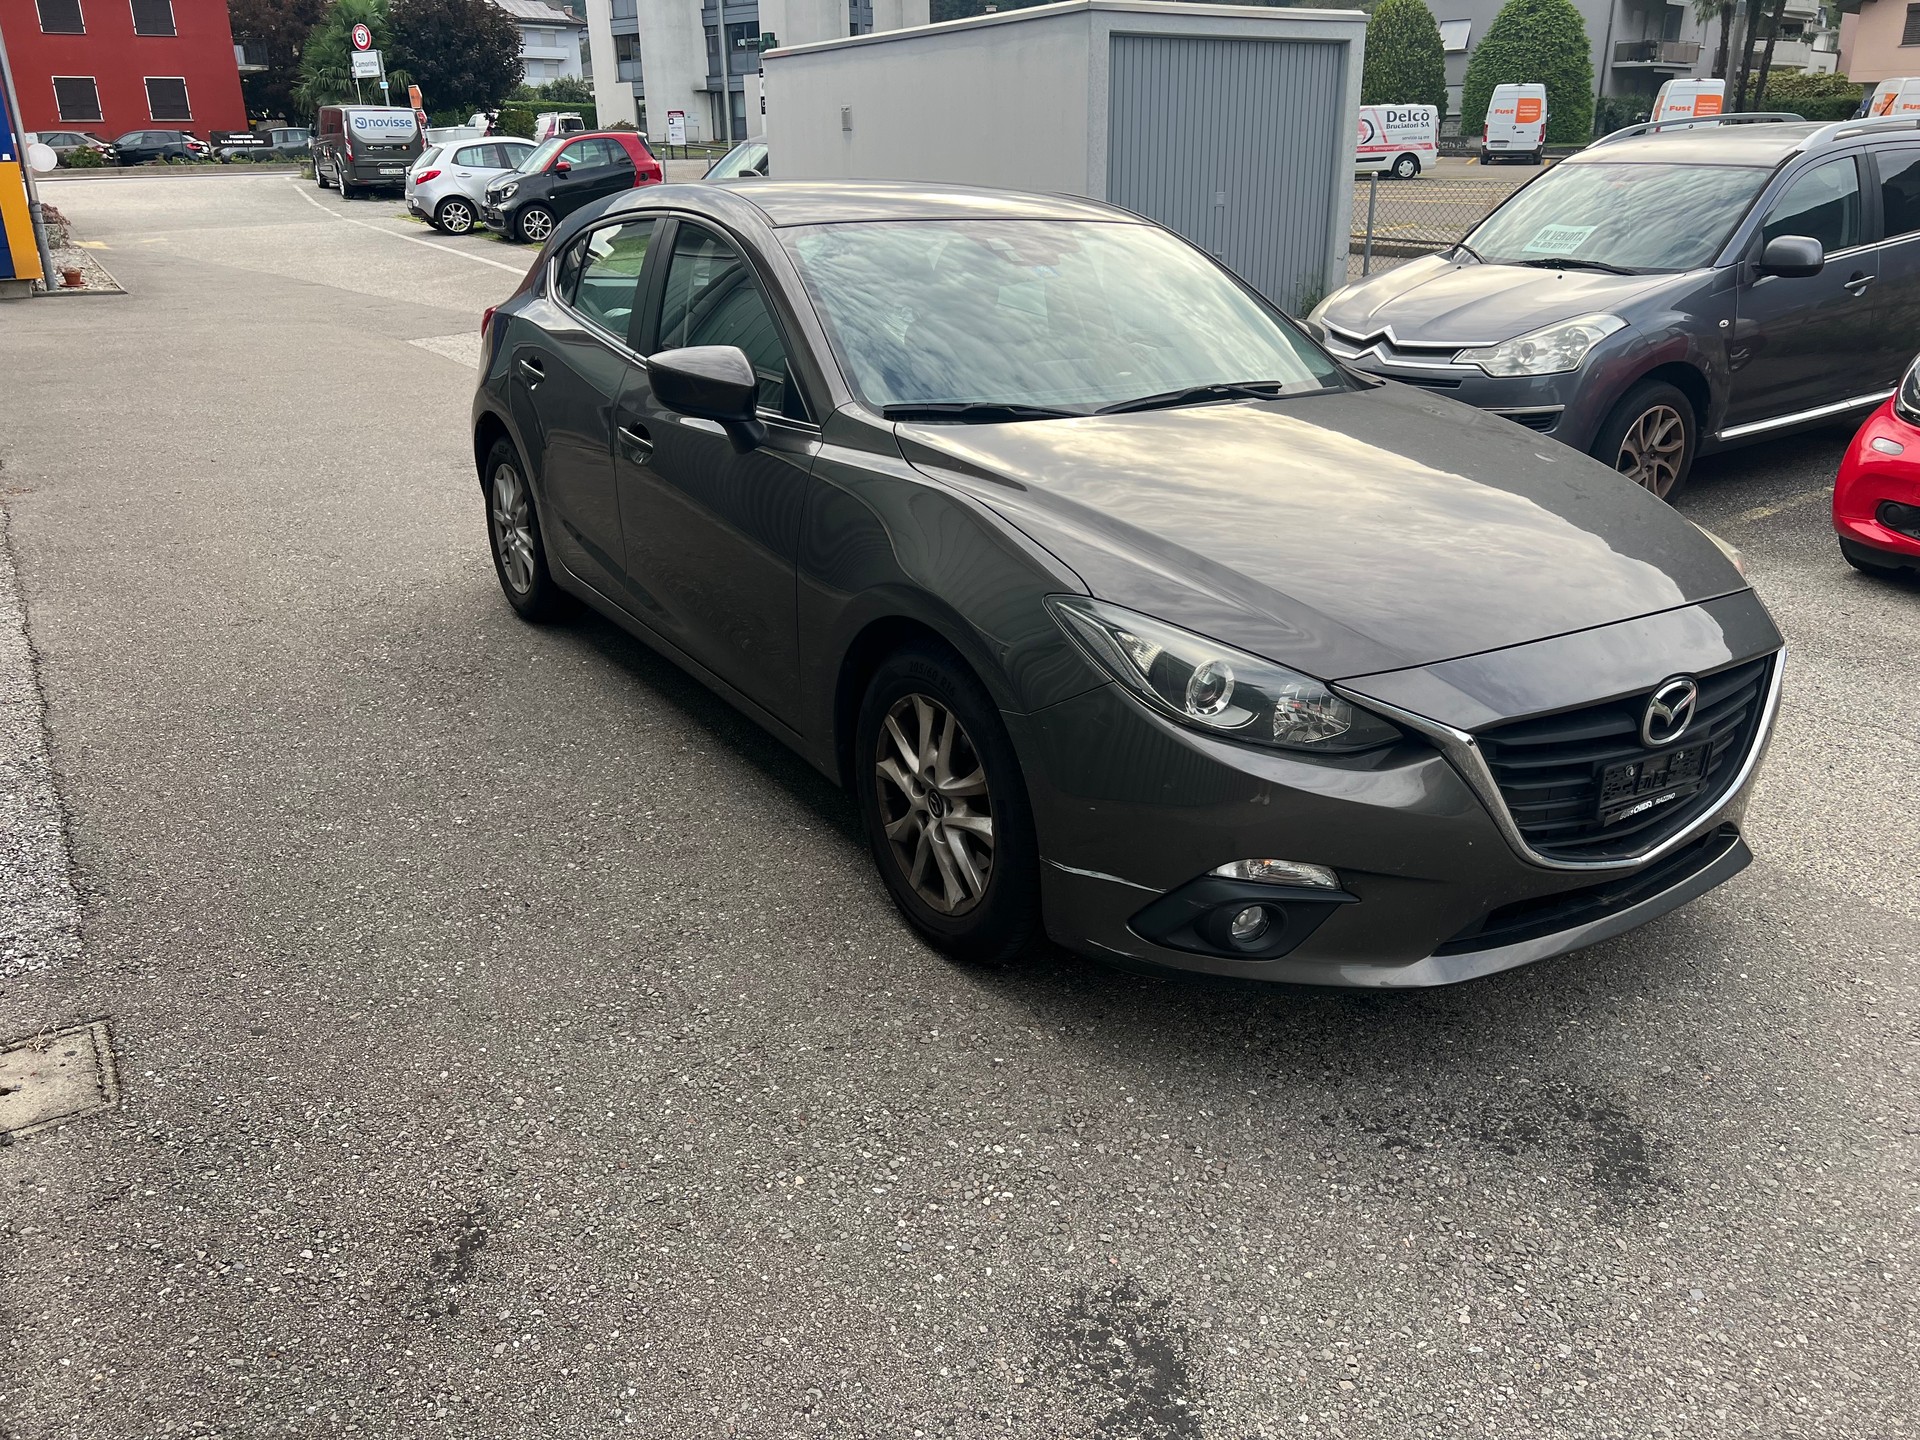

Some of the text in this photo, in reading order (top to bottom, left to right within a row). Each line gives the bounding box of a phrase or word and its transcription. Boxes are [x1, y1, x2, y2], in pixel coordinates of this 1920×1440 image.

[357, 33, 366, 42] 50
[355, 60, 378, 68] Camorino
[1386, 108, 1430, 123] Delcò
[368, 117, 413, 128] novisse
[1386, 122, 1419, 130] Bruciatori
[1537, 229, 1588, 242] IN VENDITA
[909, 660, 956, 697] 205/60 R16
